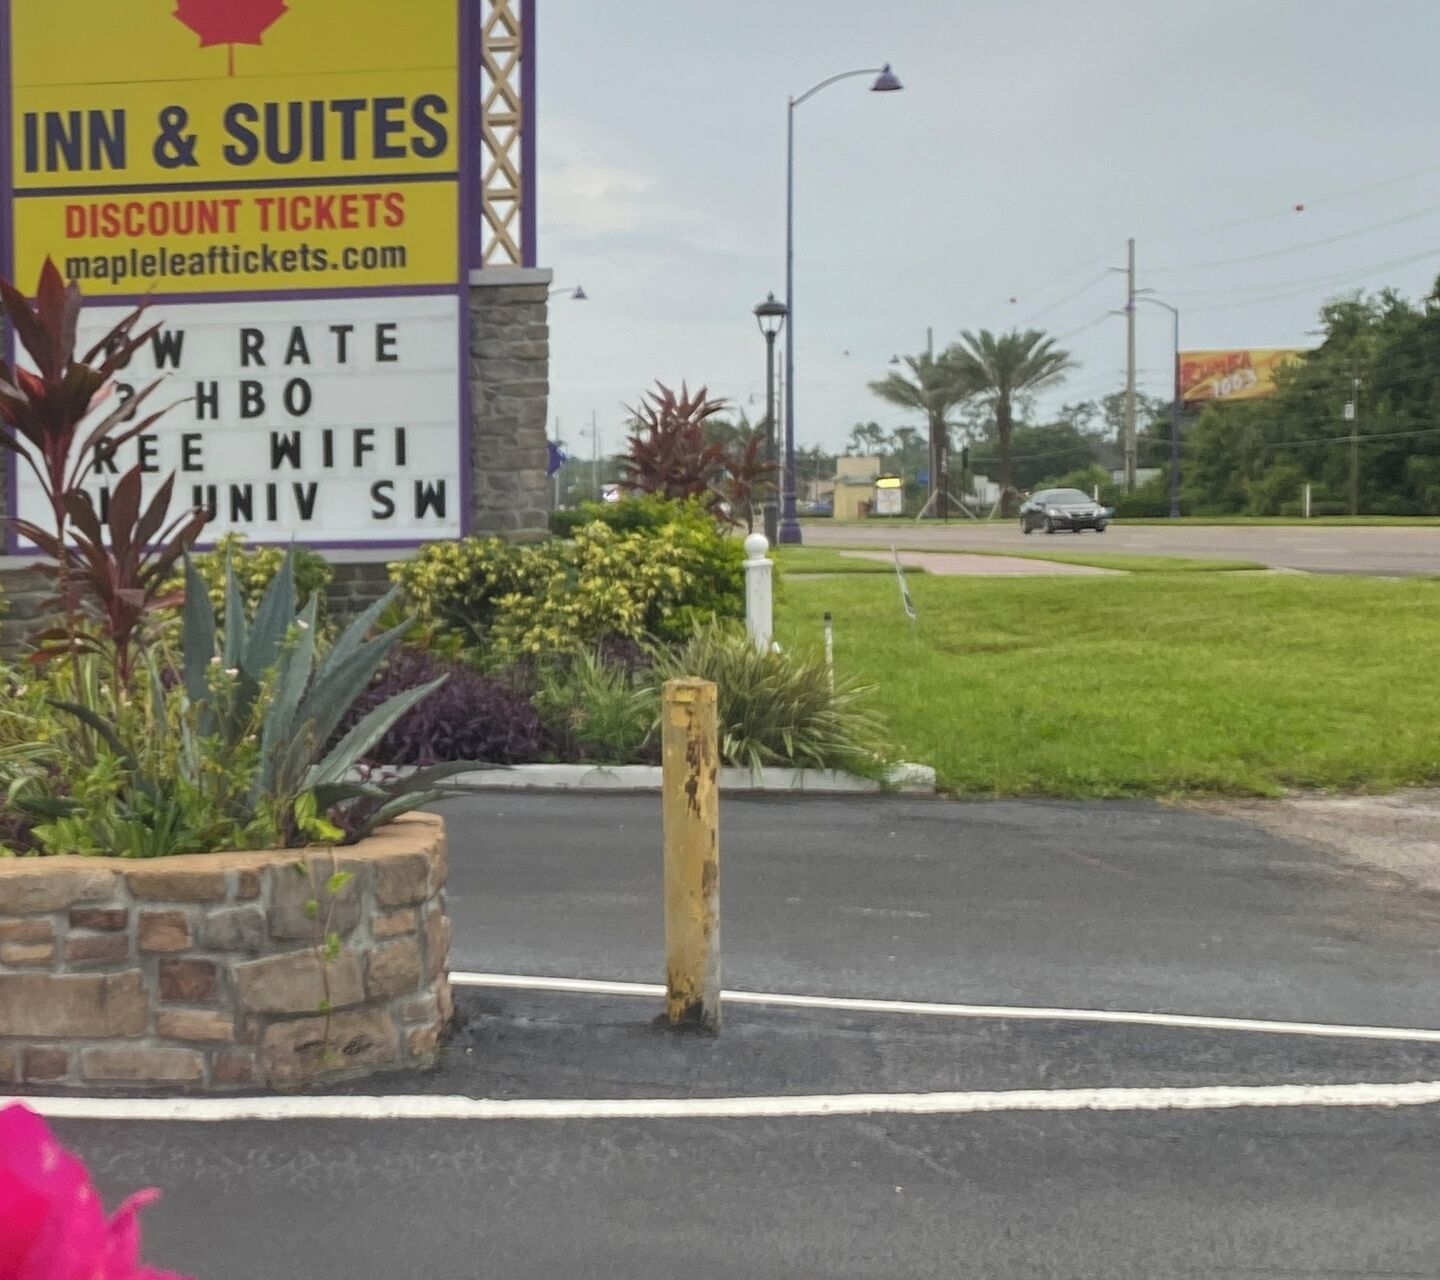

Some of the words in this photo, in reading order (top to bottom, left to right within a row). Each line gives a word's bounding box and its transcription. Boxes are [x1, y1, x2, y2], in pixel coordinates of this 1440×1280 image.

[23, 109, 126, 172] INN
[153, 105, 200, 169] &
[222, 94, 449, 166] SUITES
[65, 199, 241, 239] DISCOUNT
[254, 192, 406, 233] TICKETS
[65, 243, 407, 285] mapleleaftickets.com
[240, 323, 398, 367] RATE
[196, 377, 312, 420] HBO
[94, 433, 205, 474] REE
[270, 427, 406, 470] WIFI
[192, 482, 317, 522] UNIV
[371, 479, 447, 520] SW
